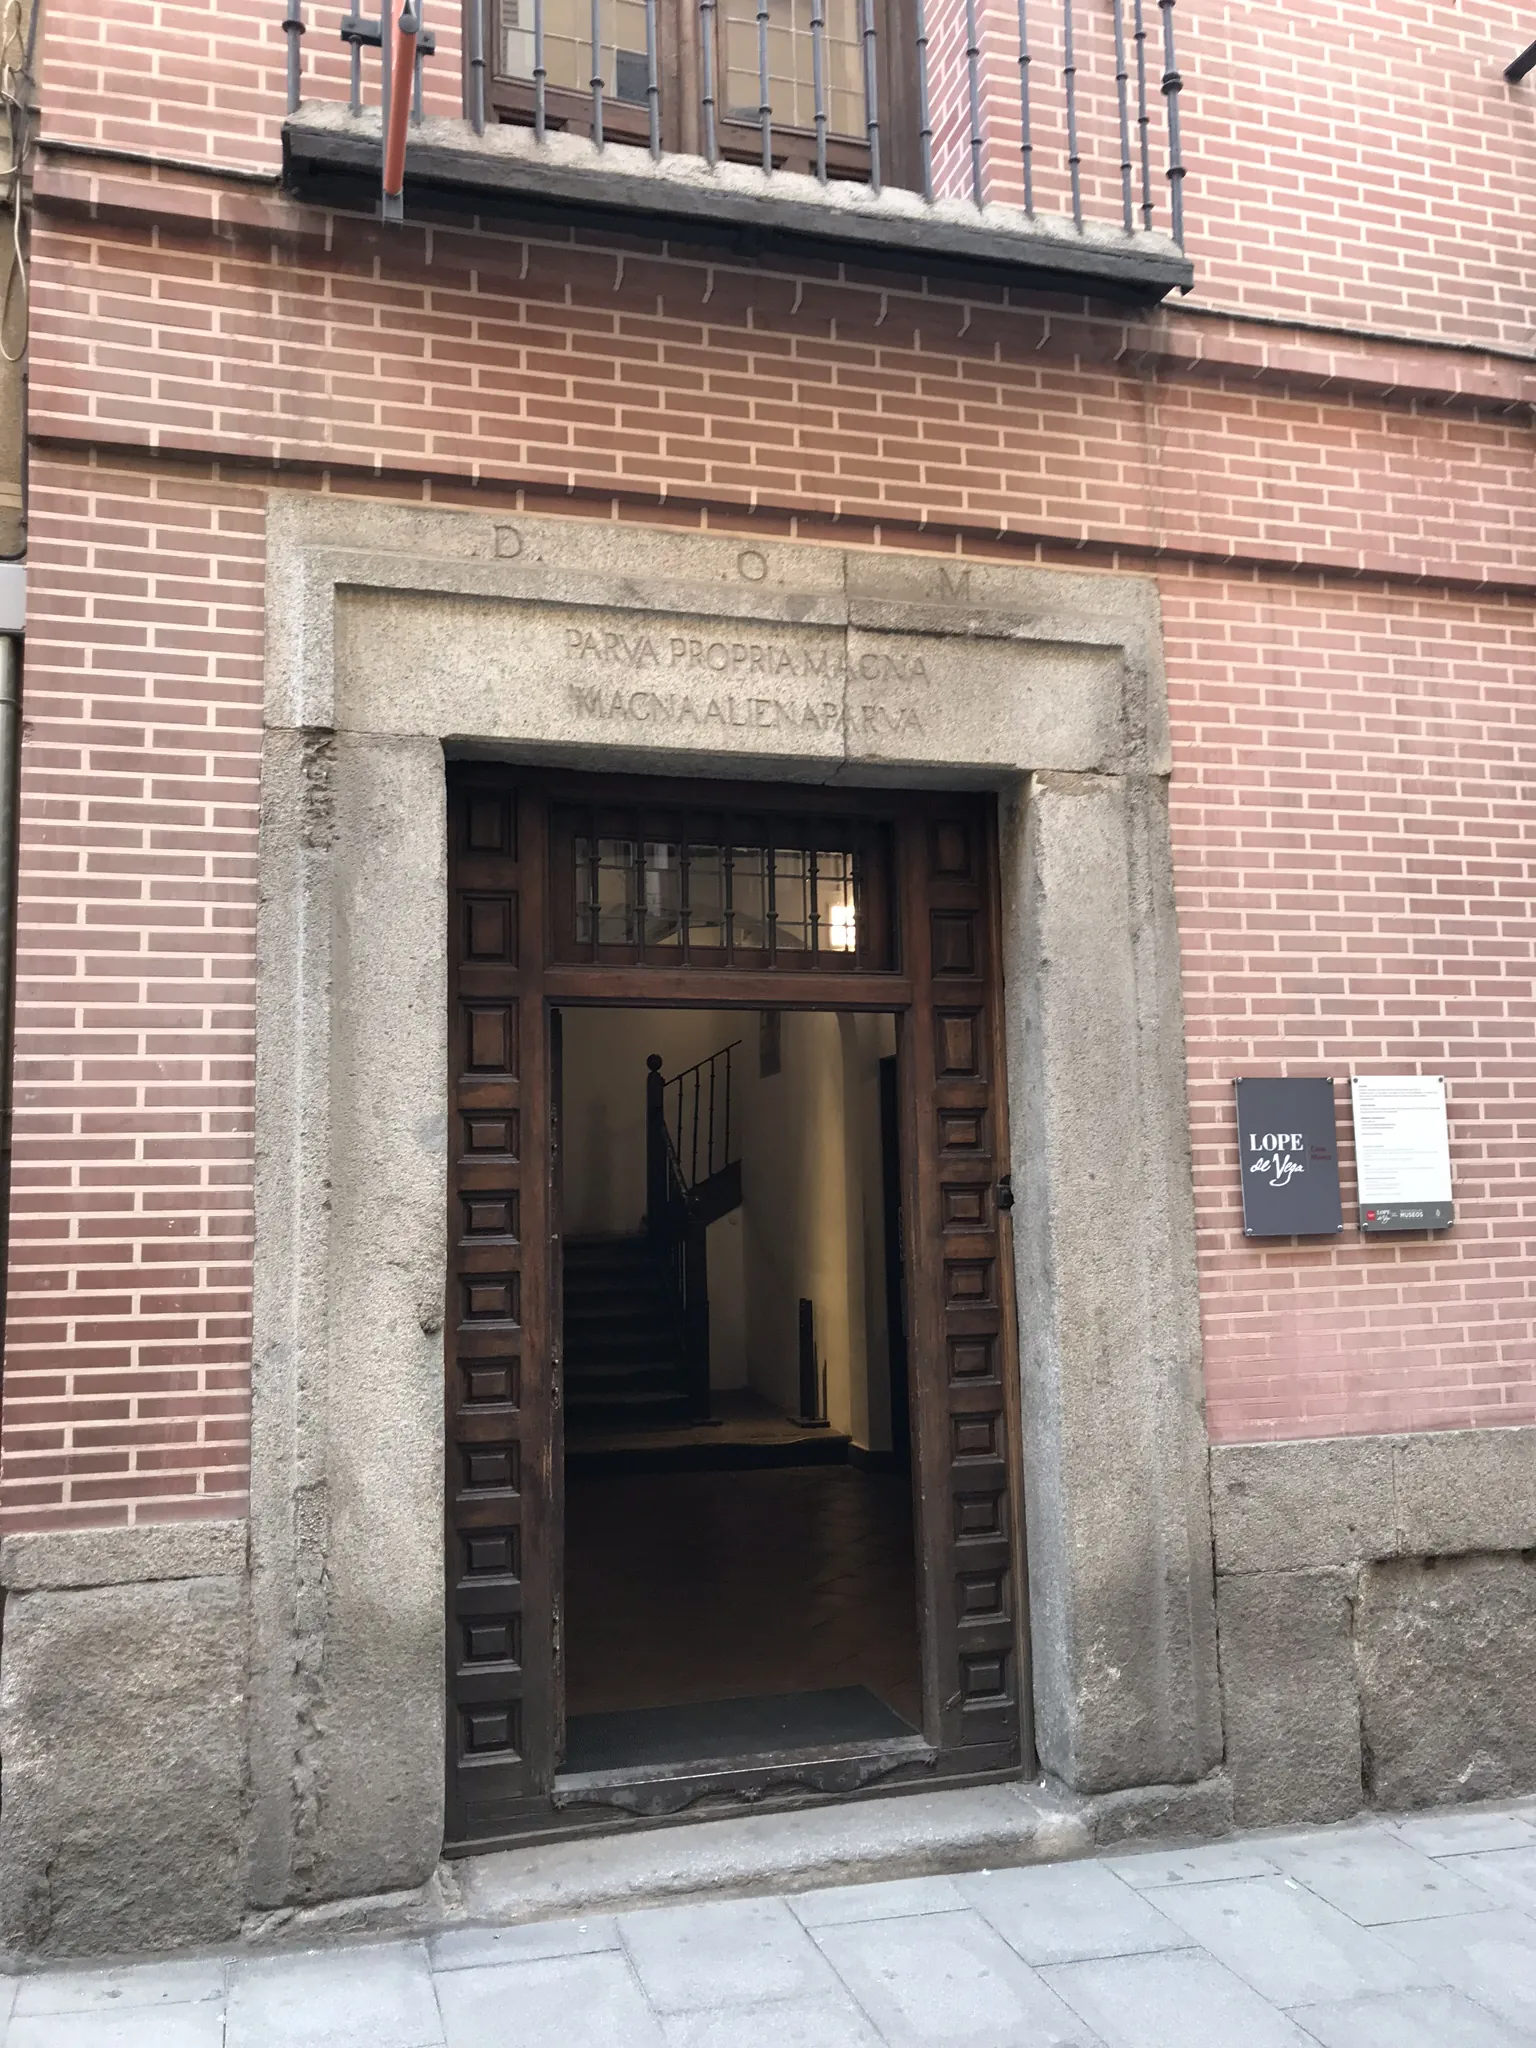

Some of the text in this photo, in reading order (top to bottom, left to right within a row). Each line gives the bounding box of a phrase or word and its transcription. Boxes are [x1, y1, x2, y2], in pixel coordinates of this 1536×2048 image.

[1249, 1133, 1304, 1151] LOPE
[1250, 1153, 1305, 1187] de Vega
